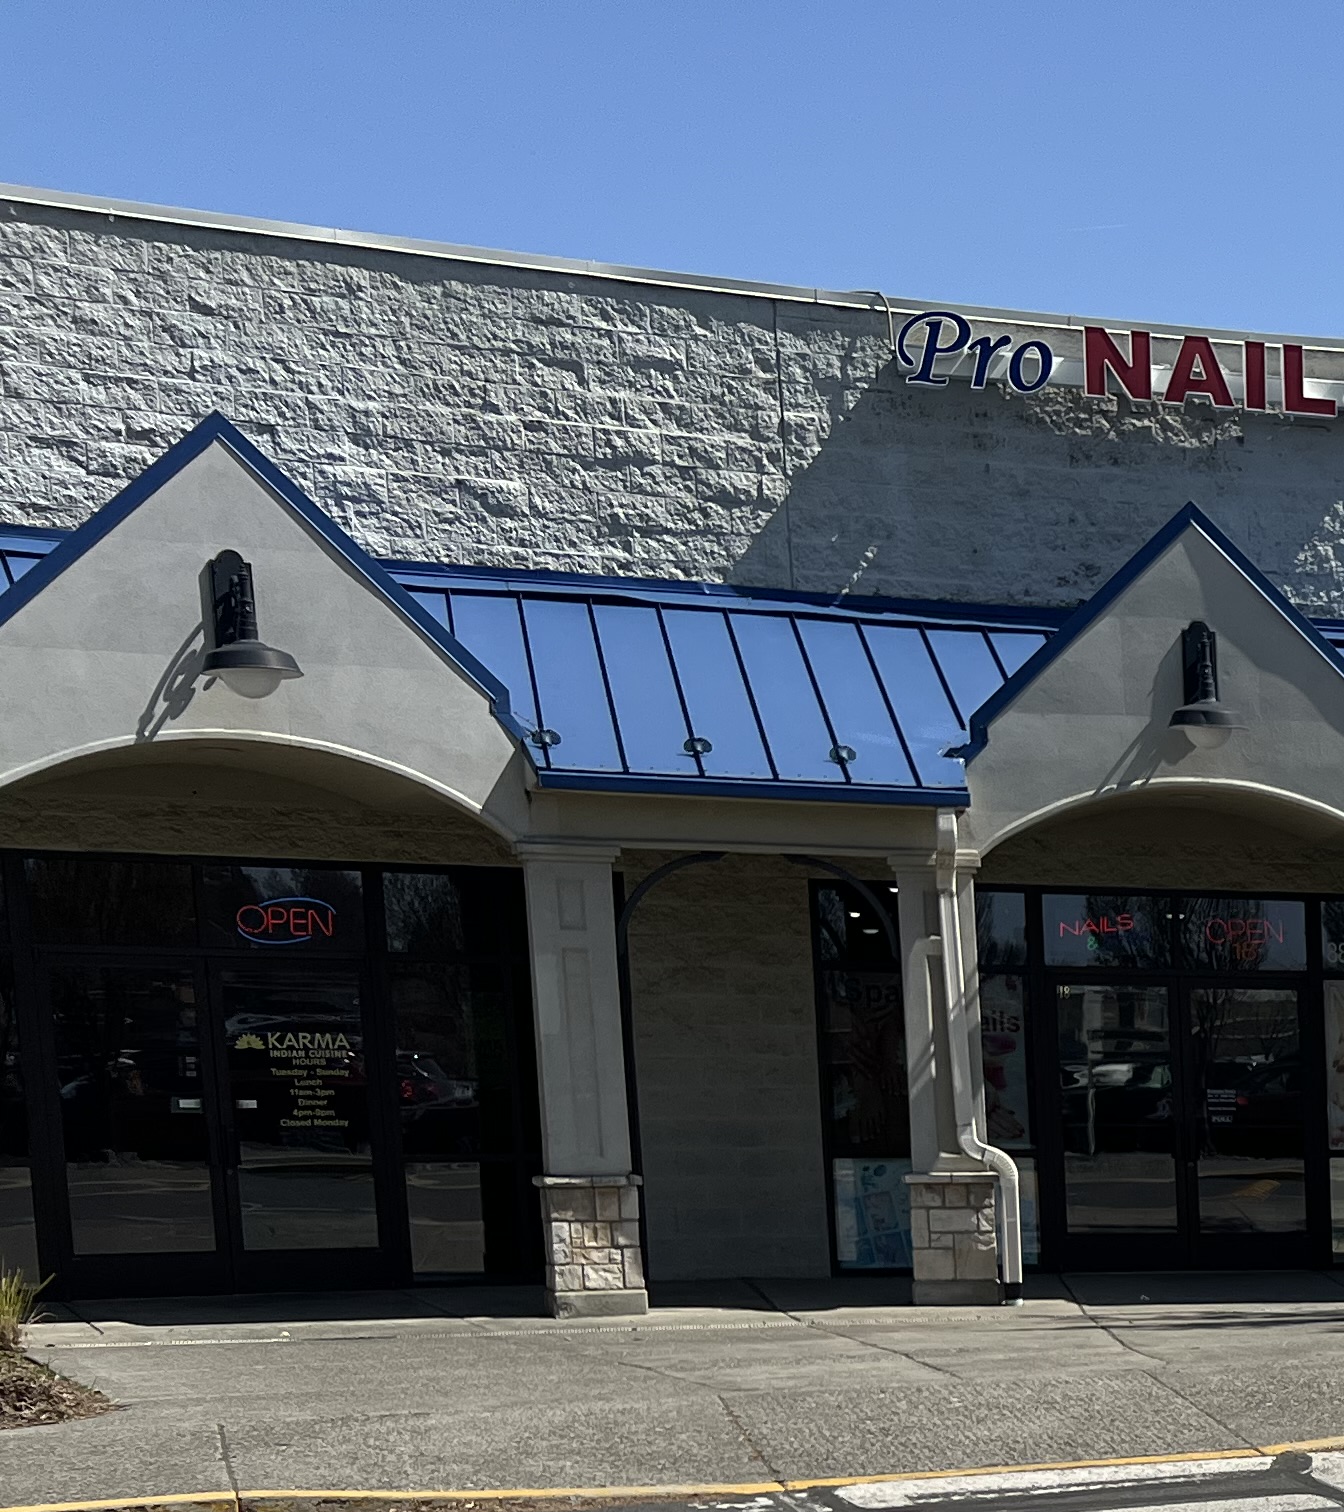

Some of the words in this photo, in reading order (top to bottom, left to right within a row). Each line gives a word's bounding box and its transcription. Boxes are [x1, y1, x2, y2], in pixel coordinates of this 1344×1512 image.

[897, 311, 1054, 393] Pro
[236, 905, 334, 936] OPEN
[1058, 912, 1135, 938] NAILS
[1205, 918, 1285, 944] OPEN
[982, 1010, 1020, 1033] ails
[267, 1032, 351, 1049] KARMA
[270, 1068, 308, 1077] Tuesday
[316, 1068, 350, 1077] Sunday
[298, 1098, 328, 1106] Dinner
[313, 1119, 349, 1127] Monday
